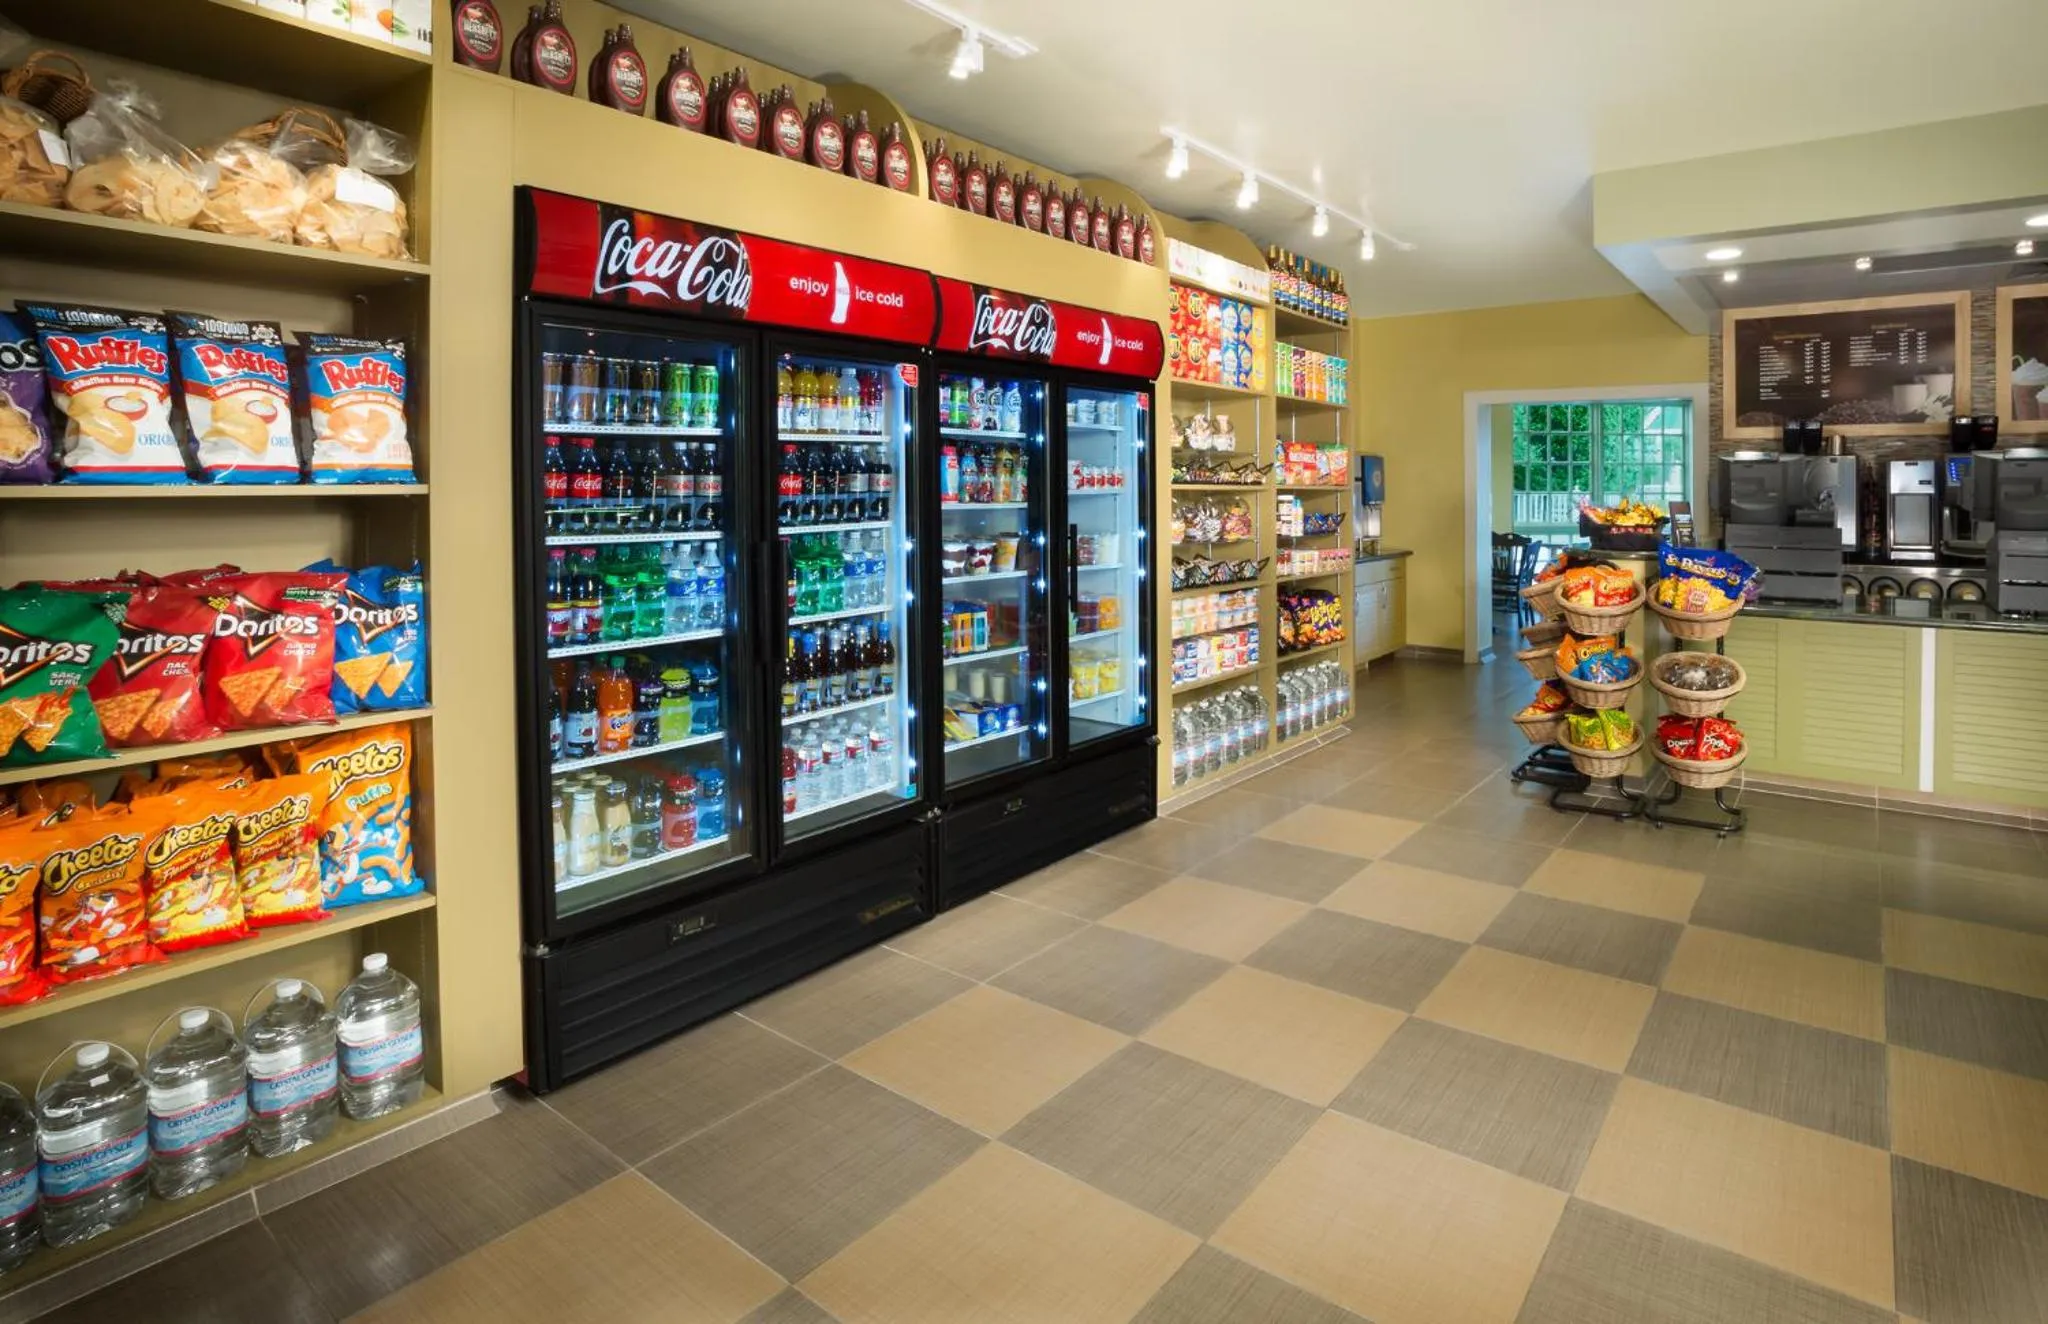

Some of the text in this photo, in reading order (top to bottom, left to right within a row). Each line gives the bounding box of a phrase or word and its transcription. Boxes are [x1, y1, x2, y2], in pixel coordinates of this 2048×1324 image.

[594, 218, 753, 309] Coca-Cola
[789, 276, 904, 308] enjoy ice cold
[969, 295, 1057, 356] Coca-Cola
[1077, 331, 1144, 351] enjoy ice cold
[47, 336, 168, 375] Ruffles
[193, 344, 288, 383] Ruffles
[320, 357, 405, 395] Ruffles
[215, 613, 319, 637] Doritos
[332, 604, 419, 625] Doritos
[0, 640, 93, 664] oritos
[118, 633, 206, 654] oritos
[309, 743, 402, 798] heetos
[238, 798, 309, 843] Cheetos
[147, 815, 234, 867] Cheetos
[42, 835, 143, 894] Cheetos
